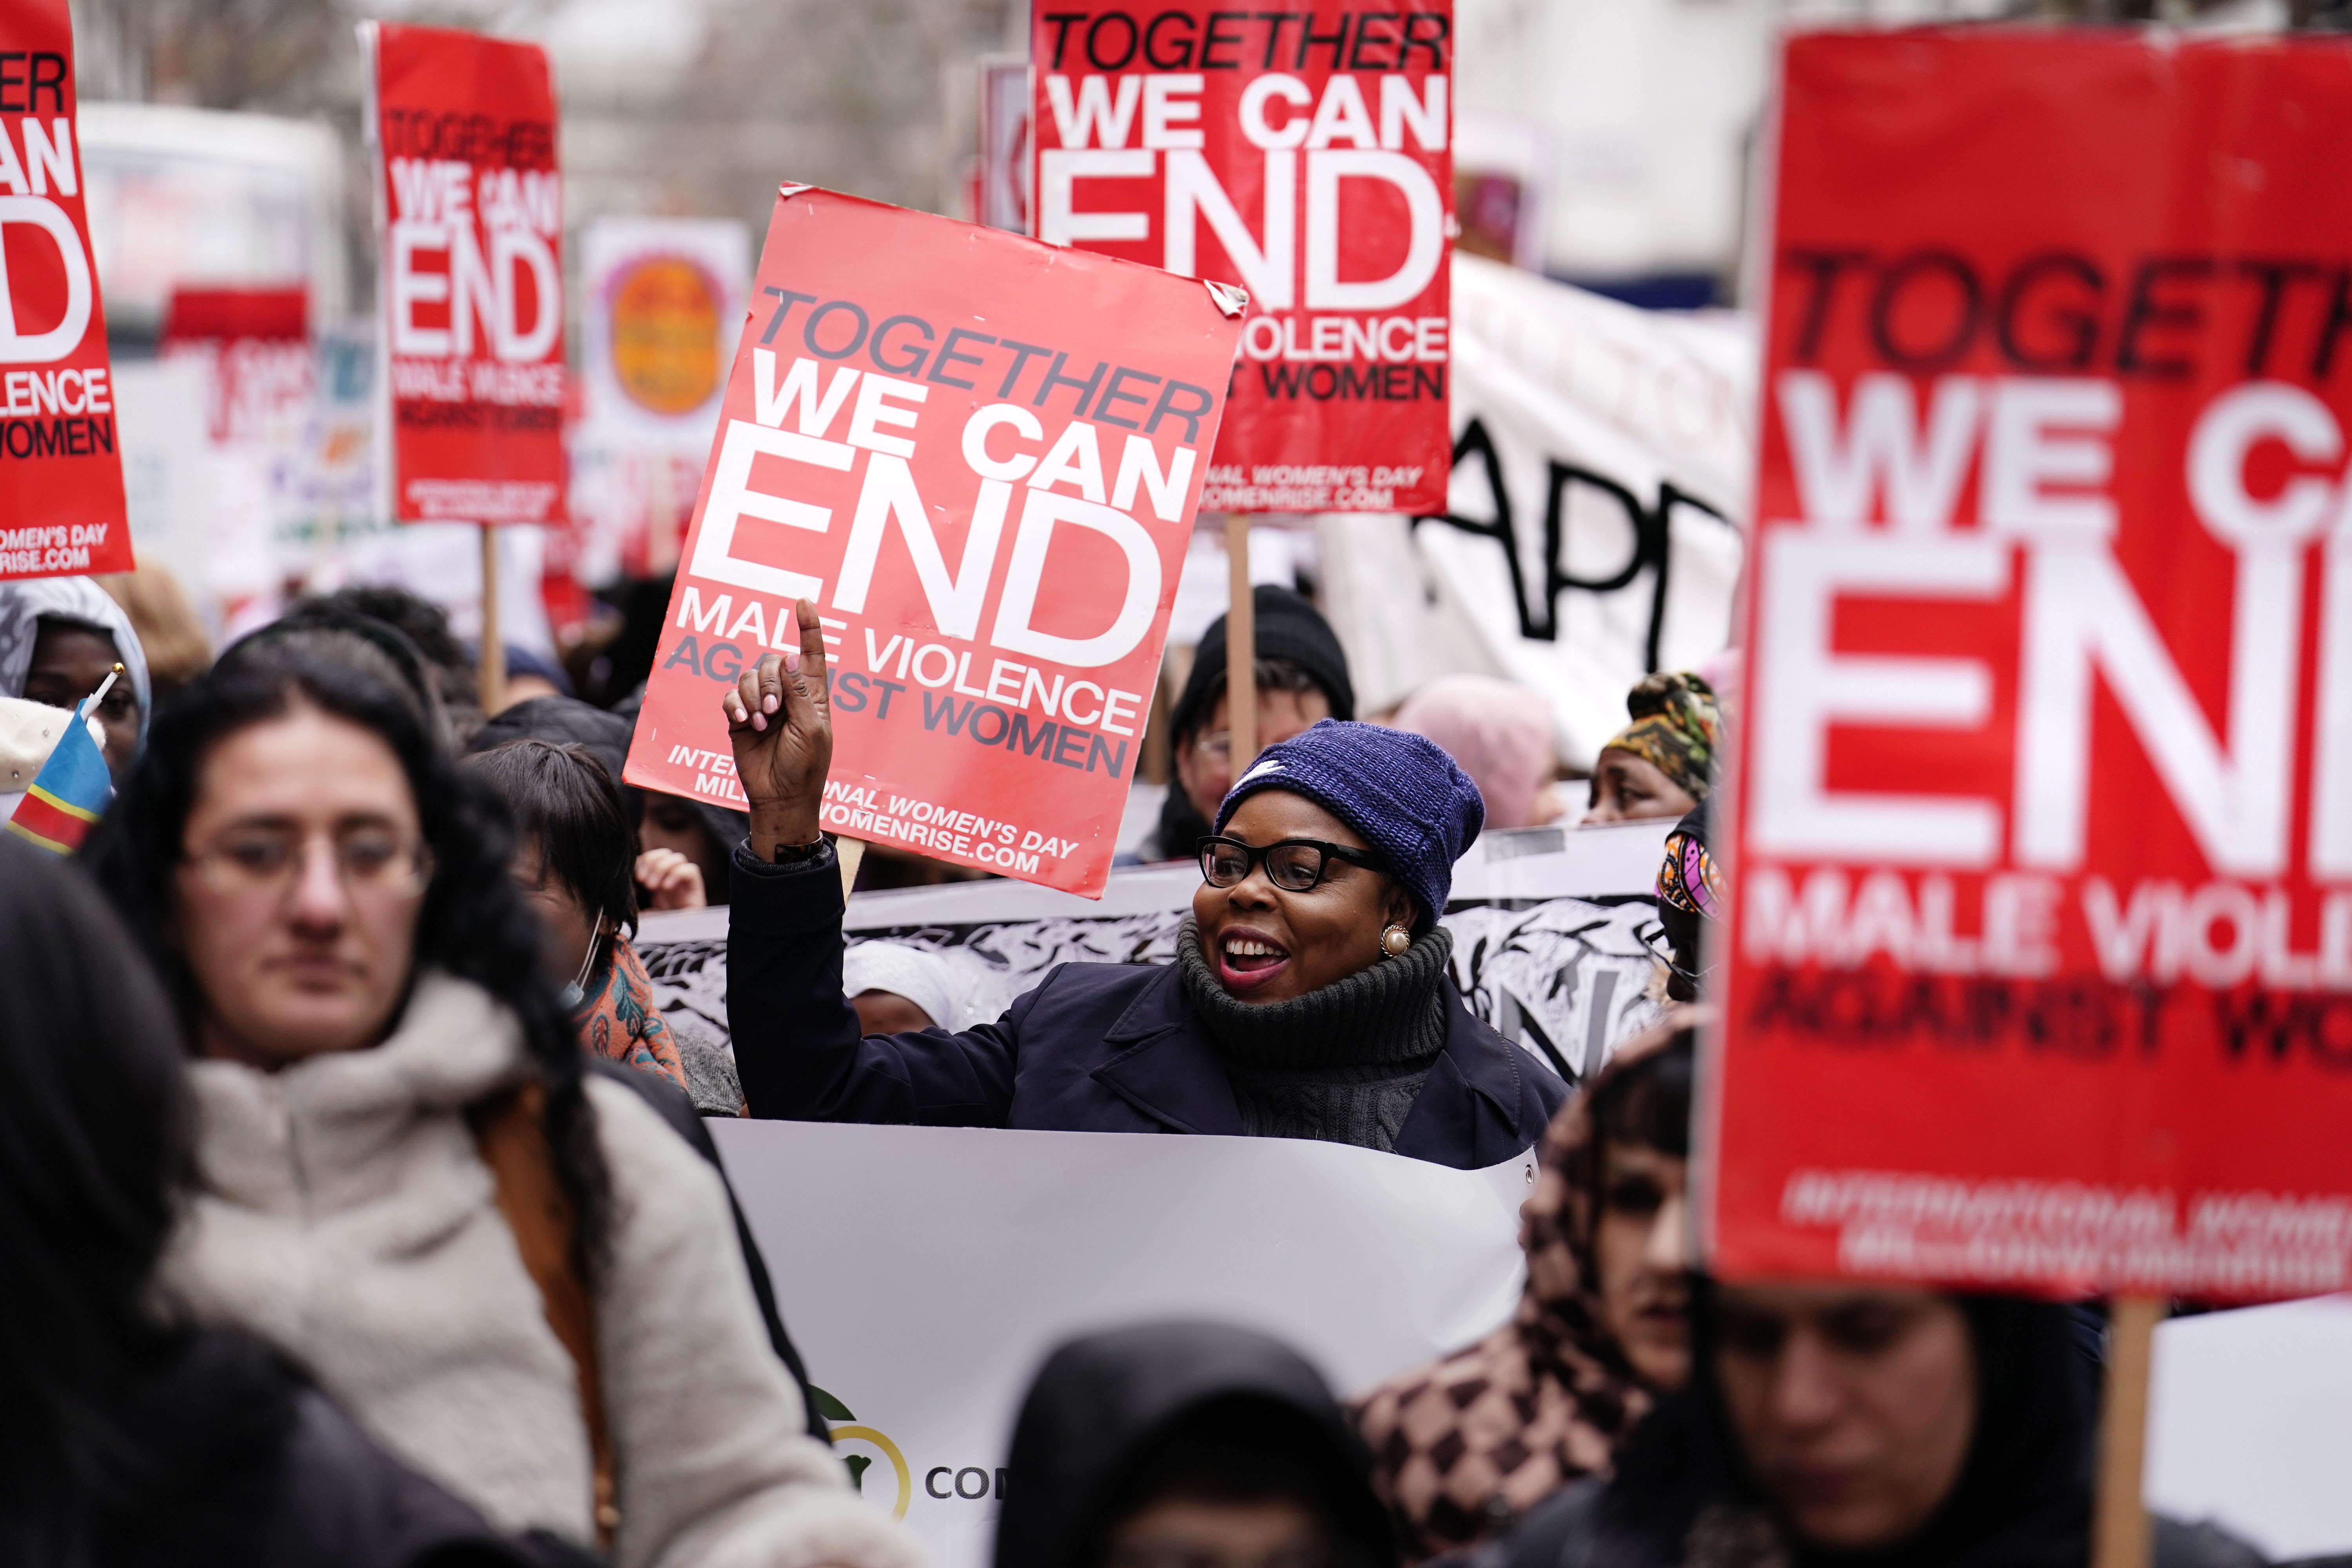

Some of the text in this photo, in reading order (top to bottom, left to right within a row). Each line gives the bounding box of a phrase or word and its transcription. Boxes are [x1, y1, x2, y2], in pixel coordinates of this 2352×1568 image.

[1043, 11, 1448, 71] TOGETHER
[1044, 73, 1447, 151] WE CAN
[1039, 148, 1445, 310] END
[393, 222, 561, 361] END
[0, 368, 111, 418] ENCE
[759, 285, 1213, 445] TOGETHER
[1261, 363, 1444, 401] WOMEN
[0, 417, 113, 459] OMEN
[752, 347, 1197, 524] WE CAN
[1370, 466, 1423, 488] DAY
[1776, 370, 2125, 545] WE
[2183, 378, 2352, 554] C
[71, 523, 108, 546] DAY
[689, 418, 1162, 667] END
[1199, 485, 1394, 508] OMENRISE.COM
[662, 635, 1127, 779] AGST WOMEN
[676, 586, 1142, 736] MALE VIOLENCE
[1746, 521, 2352, 880] EN
[667, 744, 1079, 859] INTENAL WOMEN'S DAY
[694, 773, 1040, 875] MILOMENRISE.COM
[1742, 867, 2061, 978] MALE
[1753, 970, 2172, 1059] AGAINST
